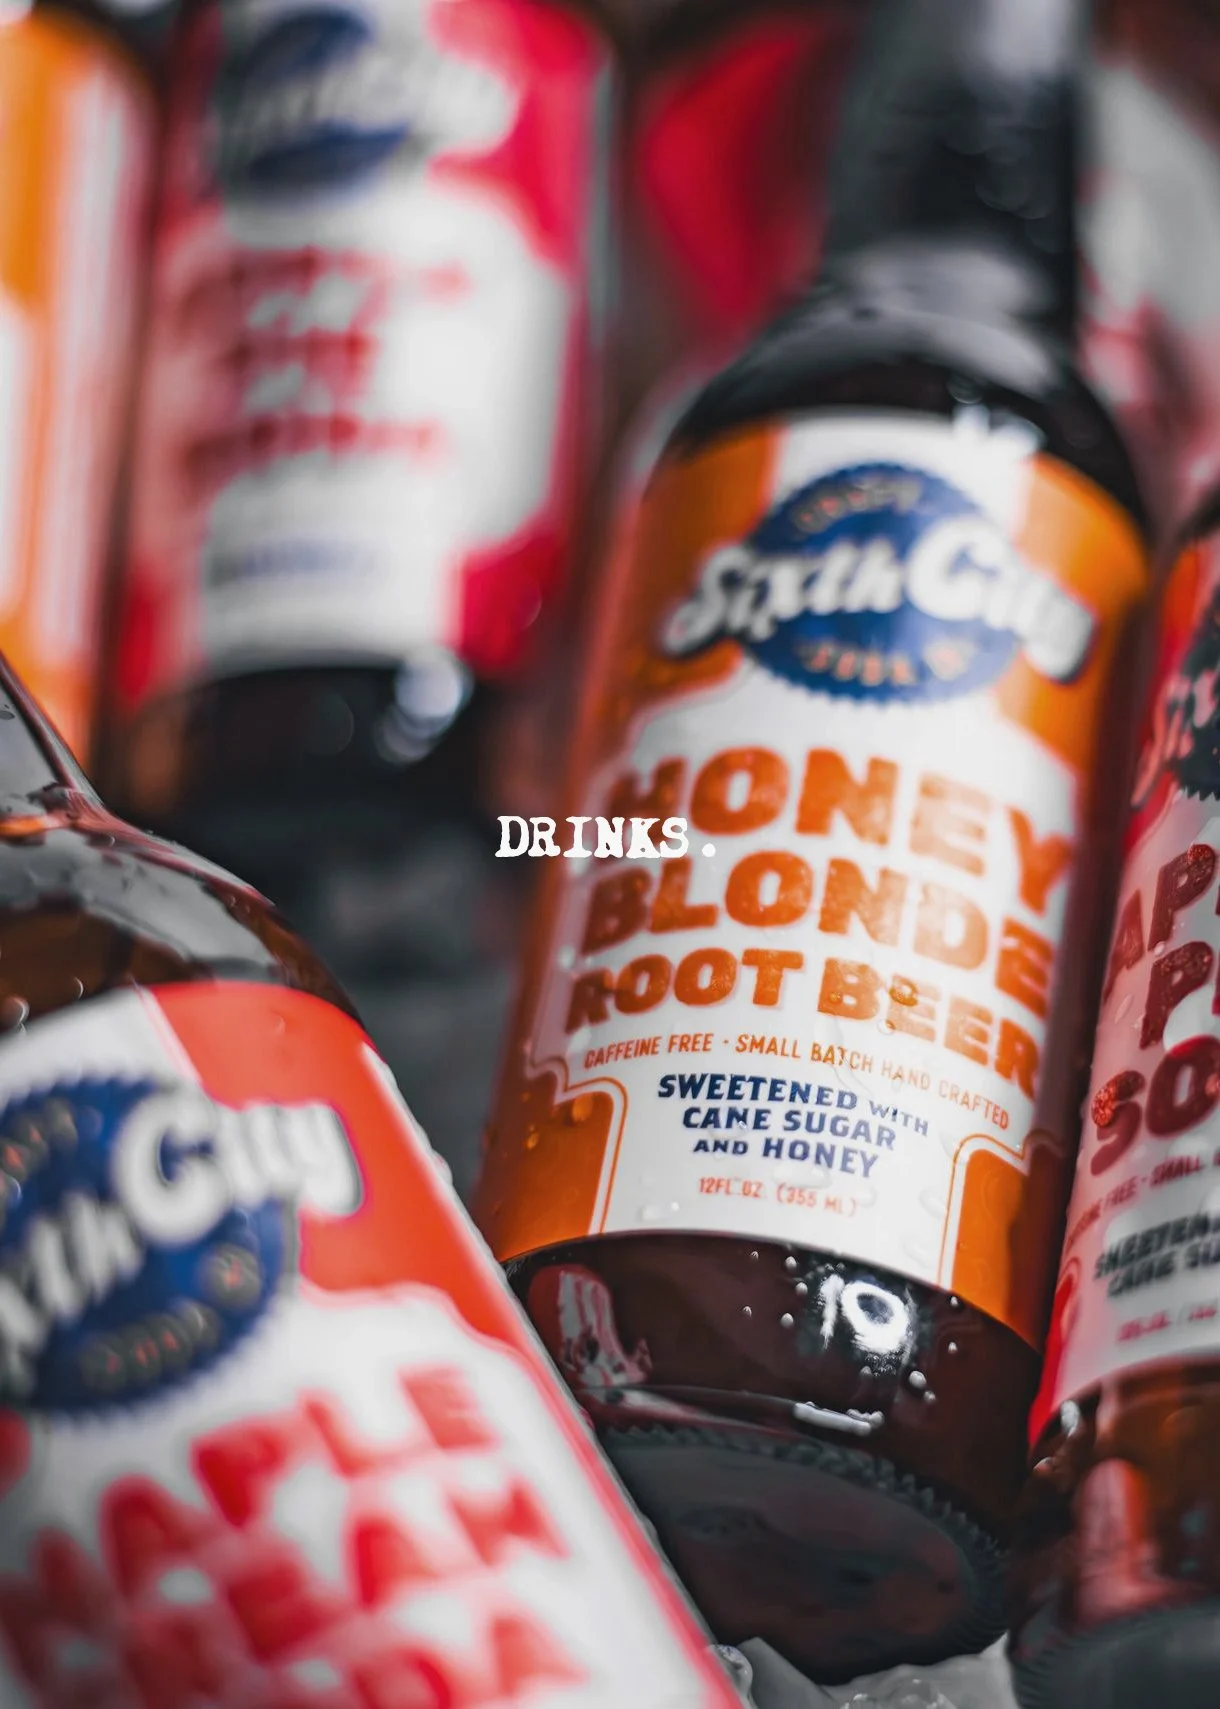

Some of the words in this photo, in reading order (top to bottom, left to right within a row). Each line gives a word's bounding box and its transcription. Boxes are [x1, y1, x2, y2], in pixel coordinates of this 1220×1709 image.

[598, 744, 1074, 918] HONEY
[579, 849, 1056, 1023] BLONDE
[564, 946, 804, 1034] ROOT
[817, 956, 1041, 1105] BEER
[584, 1035, 661, 1069] CAFFEINE
[667, 1032, 713, 1054] FREE
[735, 1034, 801, 1059] SMALL
[810, 1042, 874, 1074] BATCH
[881, 1061, 931, 1091] HAND
[938, 1079, 1010, 1130] CRAFTED
[657, 1072, 859, 1111] SWEETENED
[867, 1099, 929, 1137] WITH
[682, 1106, 771, 1131] CANE
[782, 1110, 897, 1151] SUGAR
[692, 1138, 749, 1156] AND
[761, 1137, 880, 1179] HONEY
